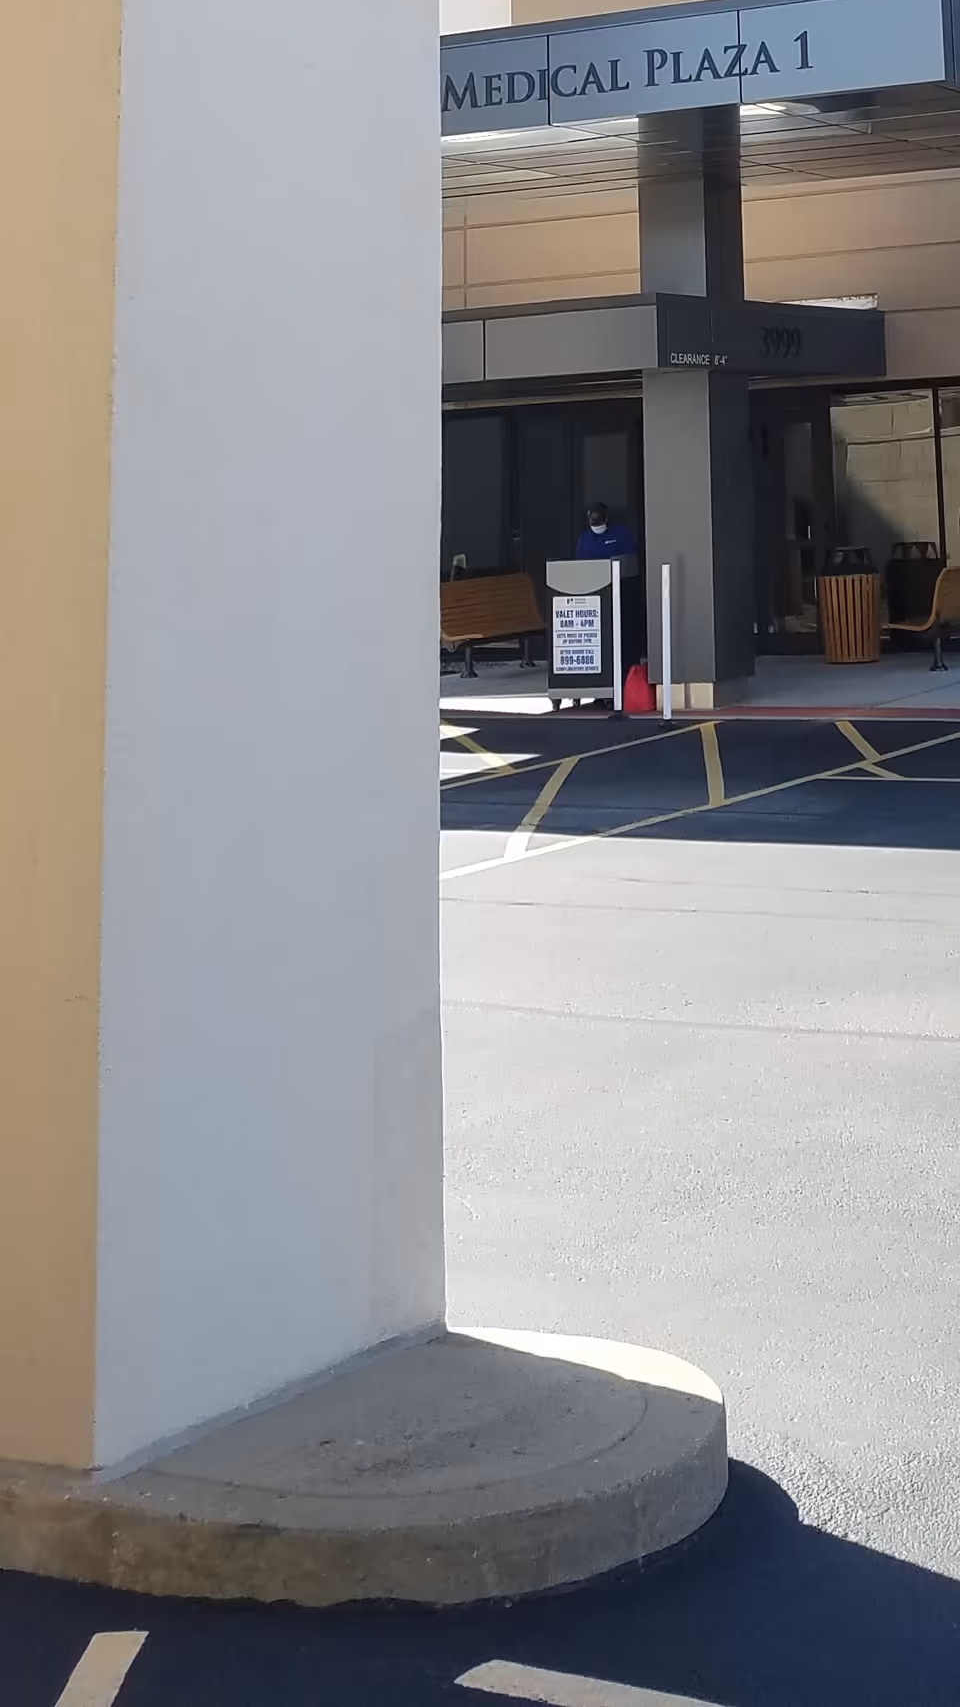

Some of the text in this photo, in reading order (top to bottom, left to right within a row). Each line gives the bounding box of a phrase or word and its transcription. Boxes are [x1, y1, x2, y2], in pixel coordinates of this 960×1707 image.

[441, 30, 814, 112] MEDICAL PLAZA 1
[670, 352, 710, 365] CLEARANCE
[555, 610, 574, 618] VALET
